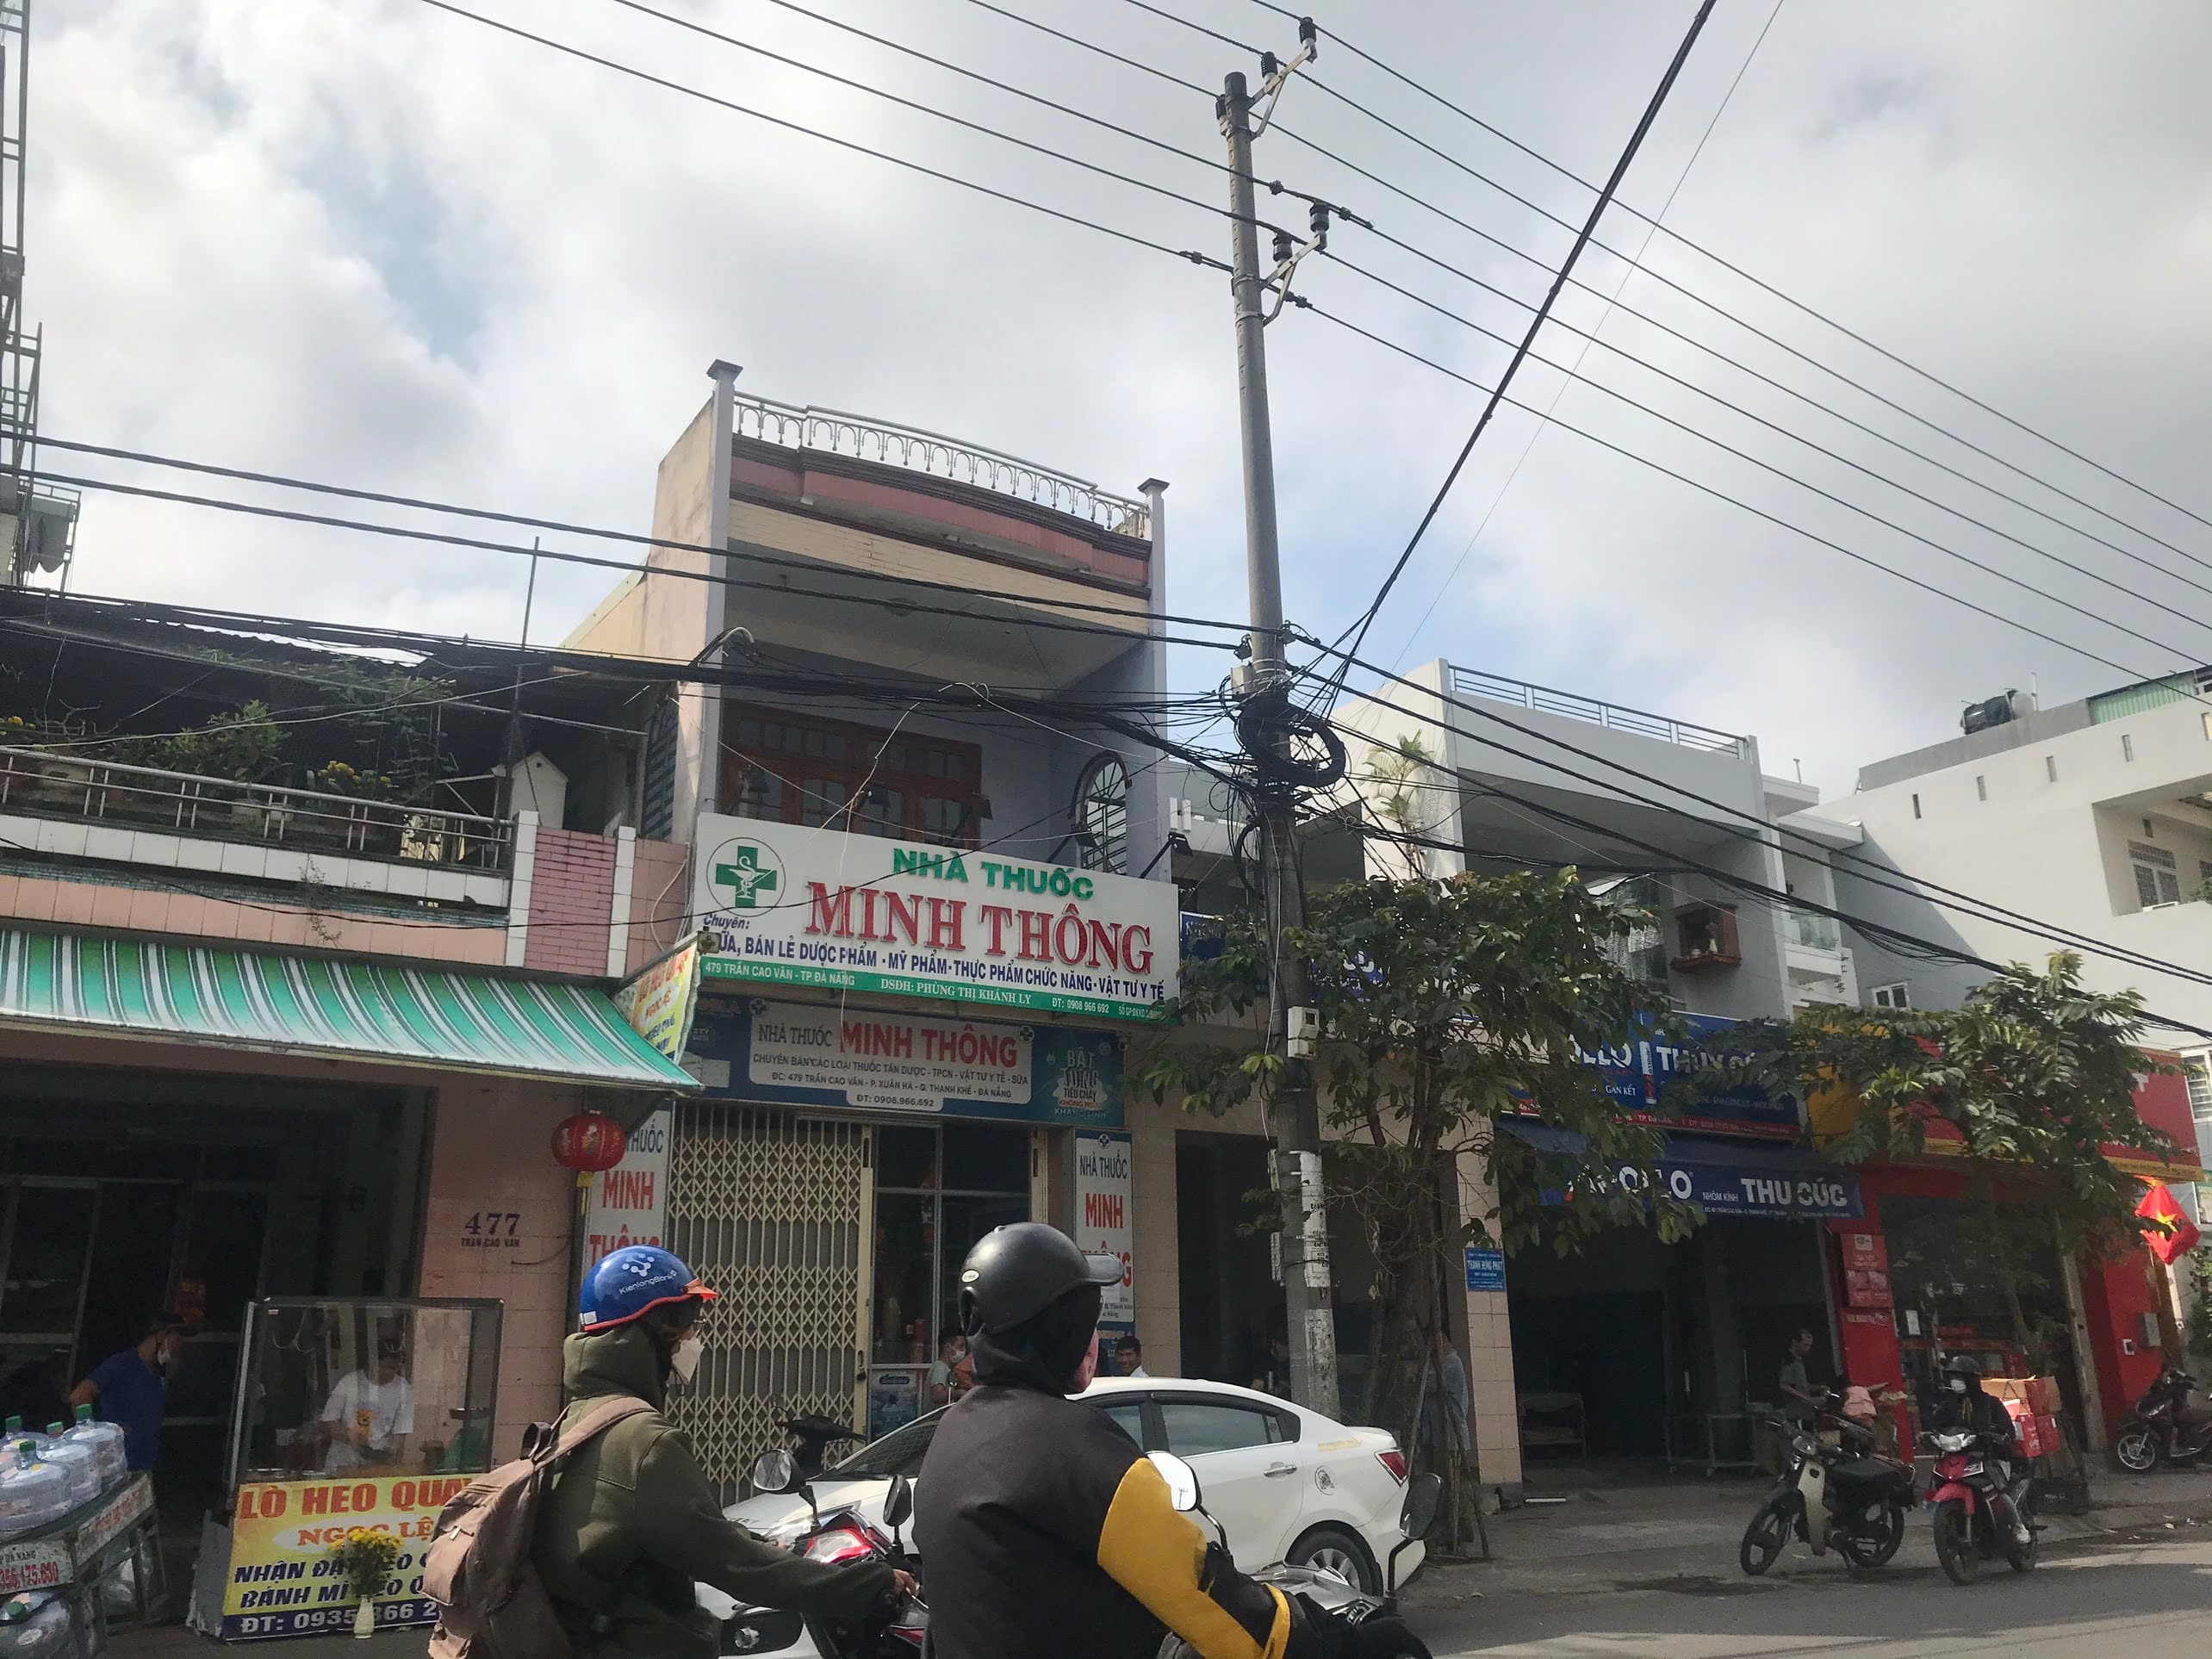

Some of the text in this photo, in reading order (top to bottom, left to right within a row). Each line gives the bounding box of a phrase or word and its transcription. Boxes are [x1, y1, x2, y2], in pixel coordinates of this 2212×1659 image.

[893, 848, 1095, 901] NHÀ THUỐC
[804, 881, 1155, 975] MINH THÔNG
[745, 935, 775, 955] BÁN
[779, 935, 795, 958] LẺ
[799, 942, 837, 966] DƯỢC
[840, 941, 877, 967] PHẨM
[888, 949, 908, 968] MỸ
[911, 948, 947, 974] PHẨM
[954, 959, 986, 985] THỰC
[990, 959, 1023, 984] PHẨM
[1026, 966, 1058, 986] CHỨC
[1061, 970, 1092, 992] NĂNG
[1099, 976, 1122, 1002] VẬT
[1123, 979, 1140, 998] TƯ
[1140, 983, 1149, 999] Y
[1151, 979, 1165, 1002] TẾ
[705, 961, 723, 974] 479
[752, 966, 773, 979] CAO
[800, 970, 812, 981] TP
[815, 971, 827, 984] ĐÀ
[916, 980, 955, 997] PHÙNG
[958, 987, 977, 1000] THỊ
[979, 988, 1016, 1004] KHÁNH
[1019, 993, 1032, 1005] LY
[1052, 997, 1065, 1009] ĐT:
[1066, 999, 1083, 1010] 0908
[1084, 1002, 1097, 1012] 966
[1097, 1003, 1109, 1014] 692
[758, 1020, 1017, 1068] NHÀ THUỐC MINH THÔNG
[854, 1060, 881, 1072] THUỐC
[828, 1076, 846, 1085] CAO
[930, 1084, 955, 1094] THANH
[857, 1095, 935, 1108] ĐT: 0908.966.692
[1080, 1149, 1128, 1179] NHÀ THUỐC
[602, 1170, 655, 1210] MINH
[1739, 1177, 1848, 1207] THU CÚC
[464, 1213, 521, 1236] 477
[1085, 1193, 1124, 1229] MINH
[239, 1476, 472, 1519] LÒ HEO QUA
[398, 1516, 435, 1540] LỆ
[234, 1560, 307, 1585] NHẬN
[240, 1585, 312, 1609] BÁNH
[317, 1580, 351, 1602] MÌ
[240, 1615, 283, 1633] ĐT:
[294, 1609, 356, 1630] 0935
